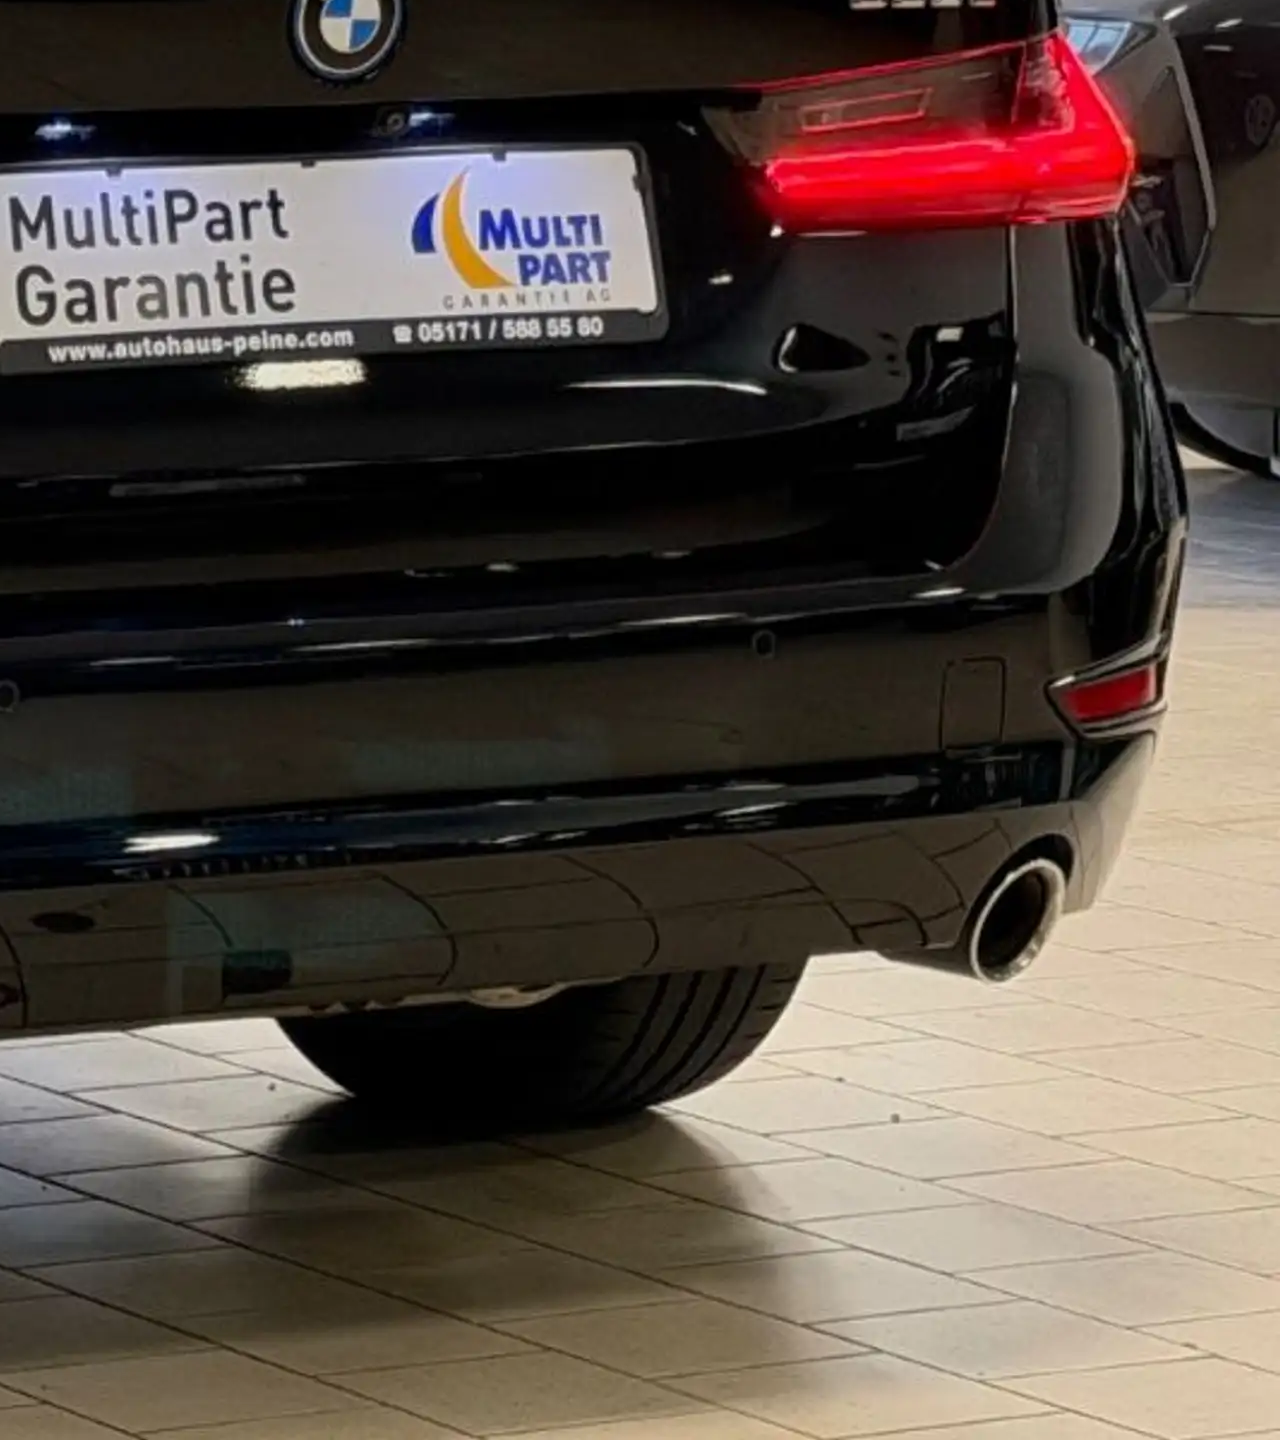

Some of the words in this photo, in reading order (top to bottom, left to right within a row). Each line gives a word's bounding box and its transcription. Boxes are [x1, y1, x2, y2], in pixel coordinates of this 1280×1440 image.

[9, 189, 289, 252] MultiPart
[518, 251, 611, 286] PART
[16, 255, 296, 327] Garantie
[586, 288, 612, 304] AG
[48, 329, 356, 363] www.autohaus-peine.com
[419, 320, 481, 343] 05171
